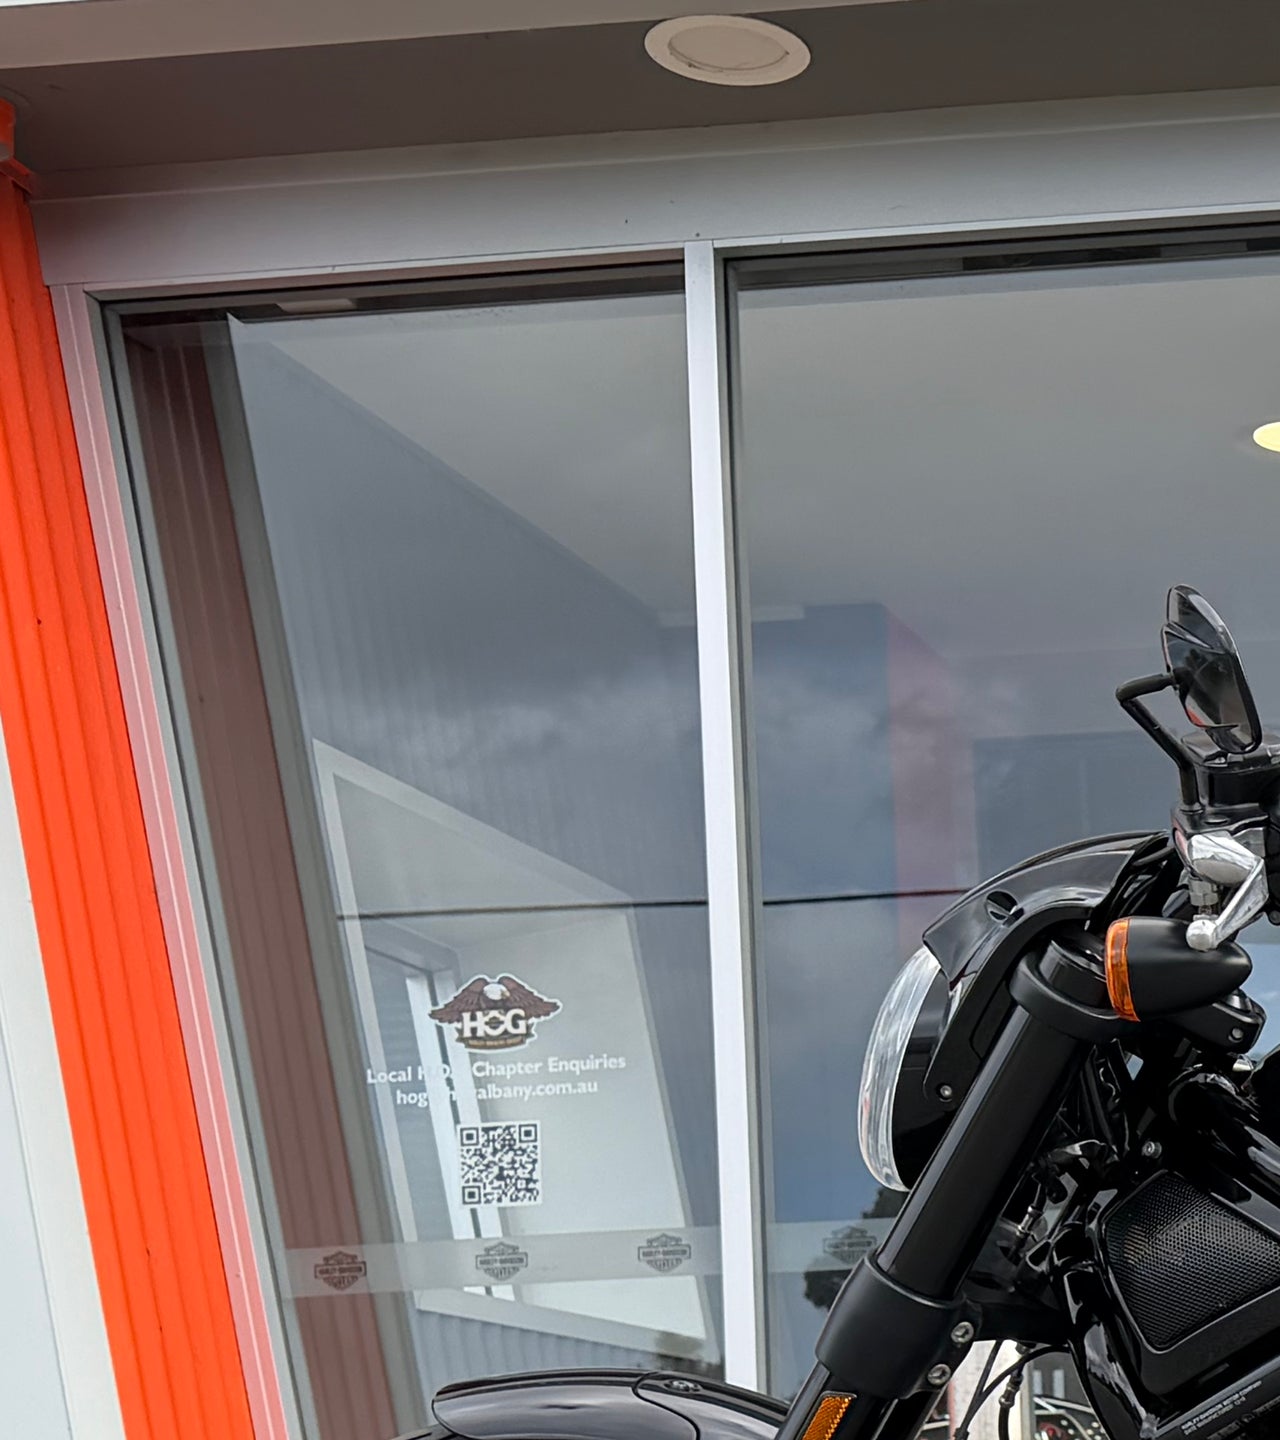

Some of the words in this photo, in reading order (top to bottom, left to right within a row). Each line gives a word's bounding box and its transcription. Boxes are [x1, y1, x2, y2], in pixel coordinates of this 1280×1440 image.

[366, 1066, 412, 1084] Local
[472, 1060, 543, 1080] Chapter
[548, 1053, 626, 1076] Enquiries
